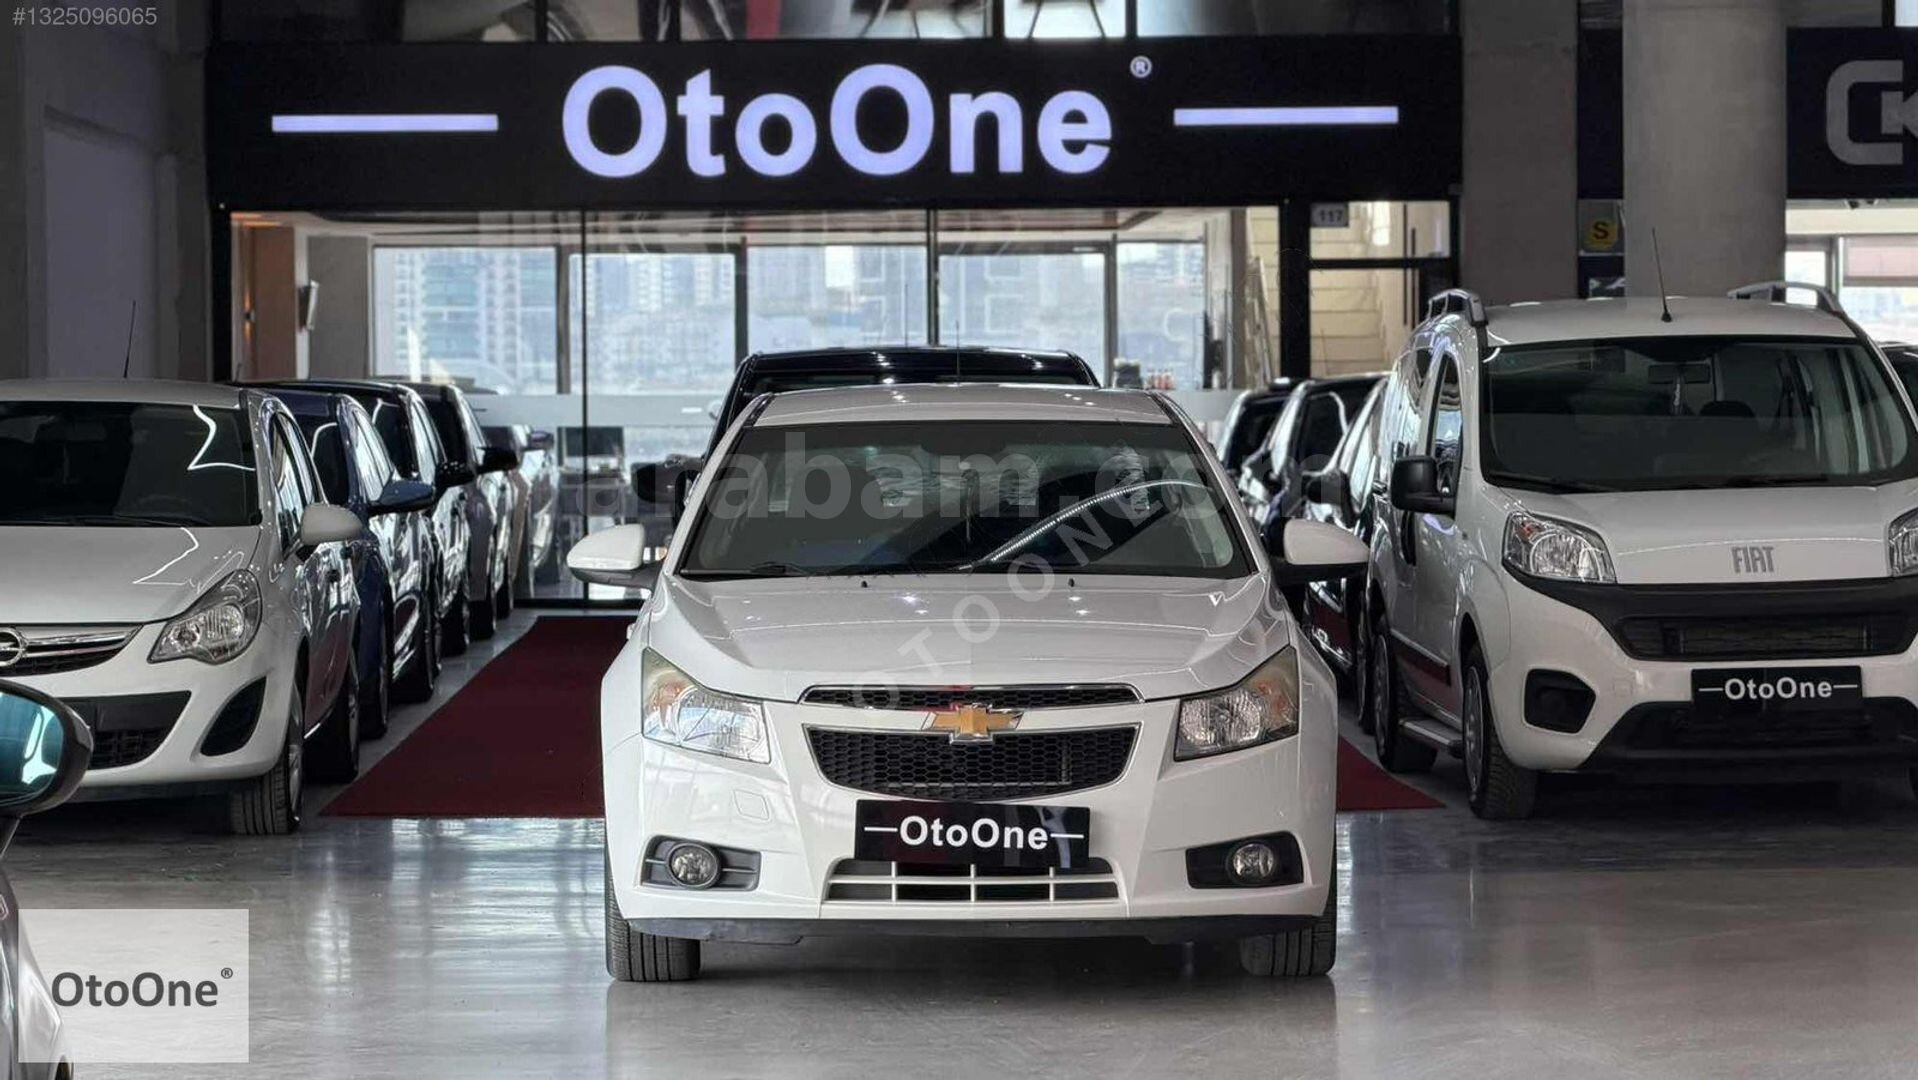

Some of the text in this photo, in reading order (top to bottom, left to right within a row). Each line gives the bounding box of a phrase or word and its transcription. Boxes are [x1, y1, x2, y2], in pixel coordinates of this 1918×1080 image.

[1593, 220, 1609, 240] S
[1731, 545, 1775, 574] FIAT
[1724, 676, 1833, 701] OtoOne
[899, 814, 1049, 851] OtoOne
